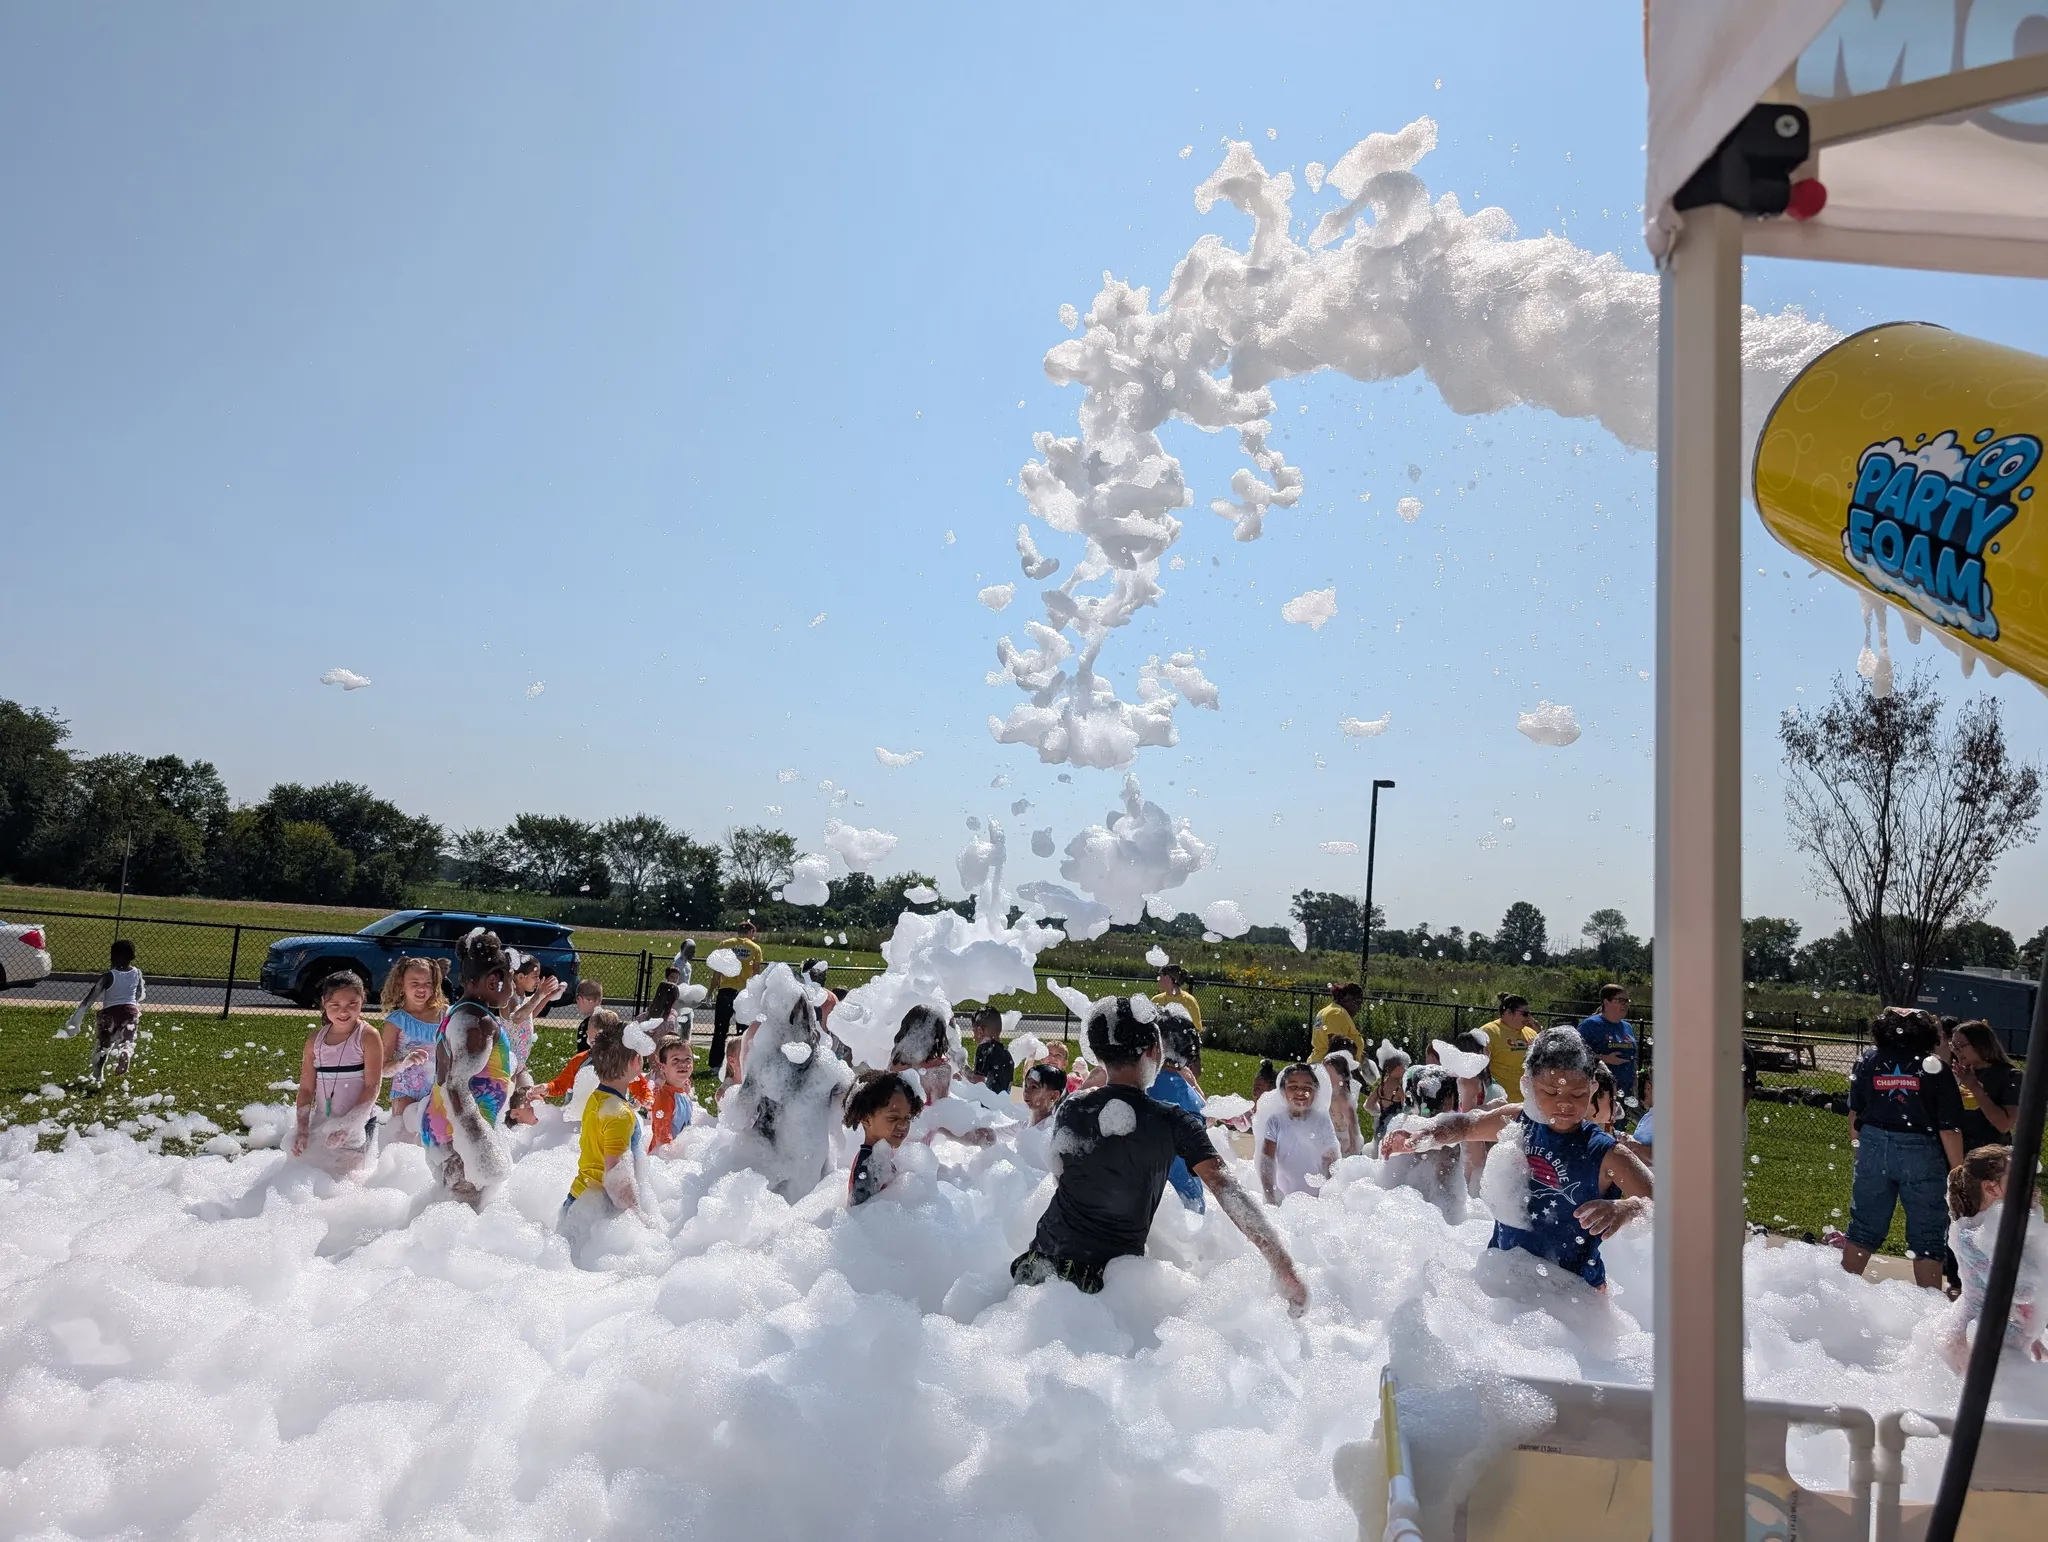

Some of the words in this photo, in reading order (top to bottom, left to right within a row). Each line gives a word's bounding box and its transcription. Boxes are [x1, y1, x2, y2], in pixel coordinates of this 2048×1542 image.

[1853, 456, 2014, 554] PARTY
[1850, 508, 1982, 618] FOAM
[1876, 1079, 1917, 1087] CHAMPIONS
[1525, 1146, 1545, 1157] BITE
[1545, 1151, 1553, 1160] &
[1551, 1158, 1570, 1183] BLUE
